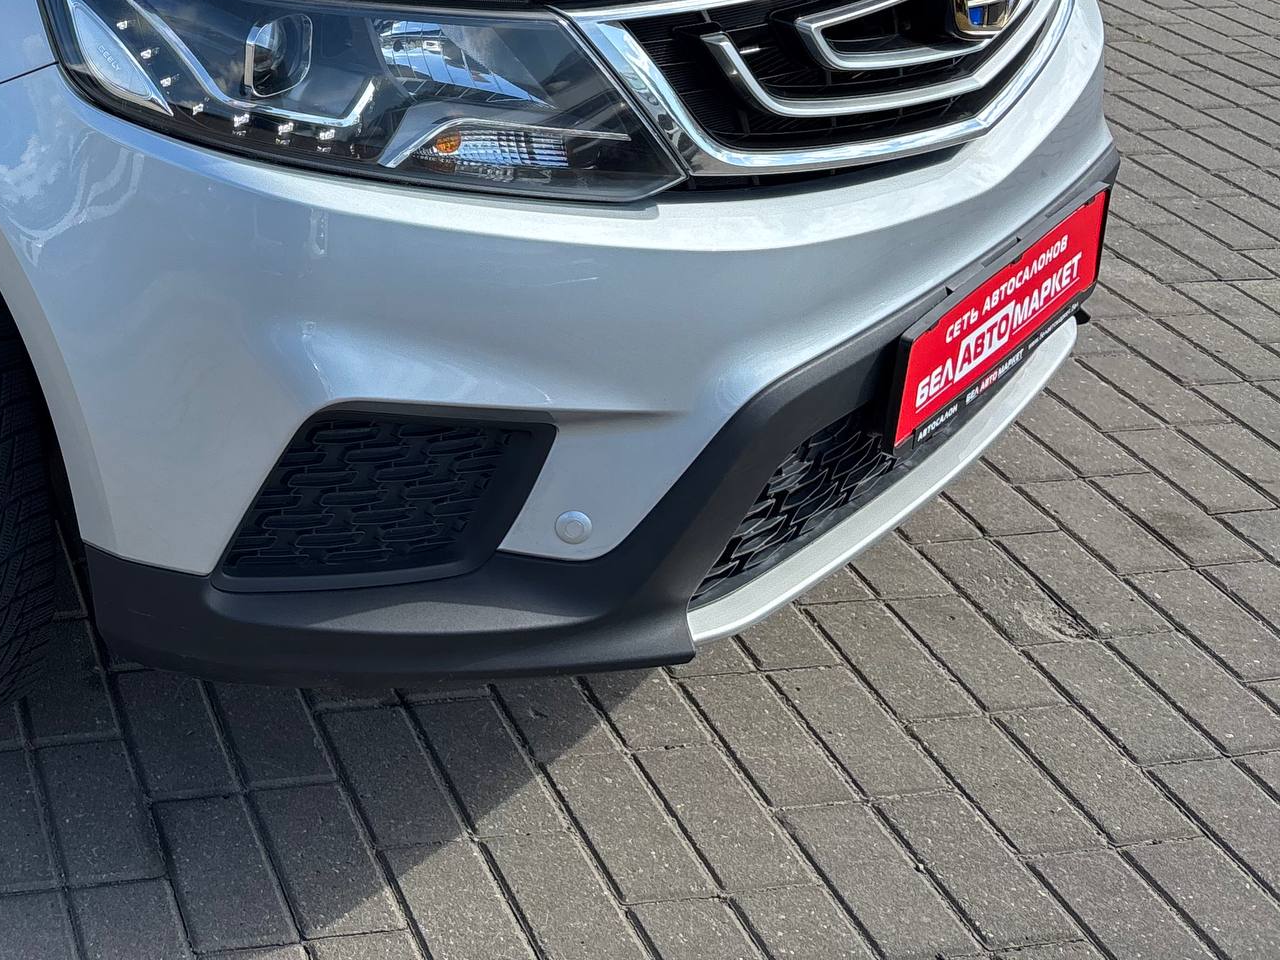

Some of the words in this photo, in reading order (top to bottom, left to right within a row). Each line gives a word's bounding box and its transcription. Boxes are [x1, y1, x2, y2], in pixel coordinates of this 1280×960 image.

[945, 307, 980, 344] СЕТЬ
[982, 234, 1069, 314] АВТОСАЛОНОВ
[917, 403, 959, 442] АВТОСАЛОН
